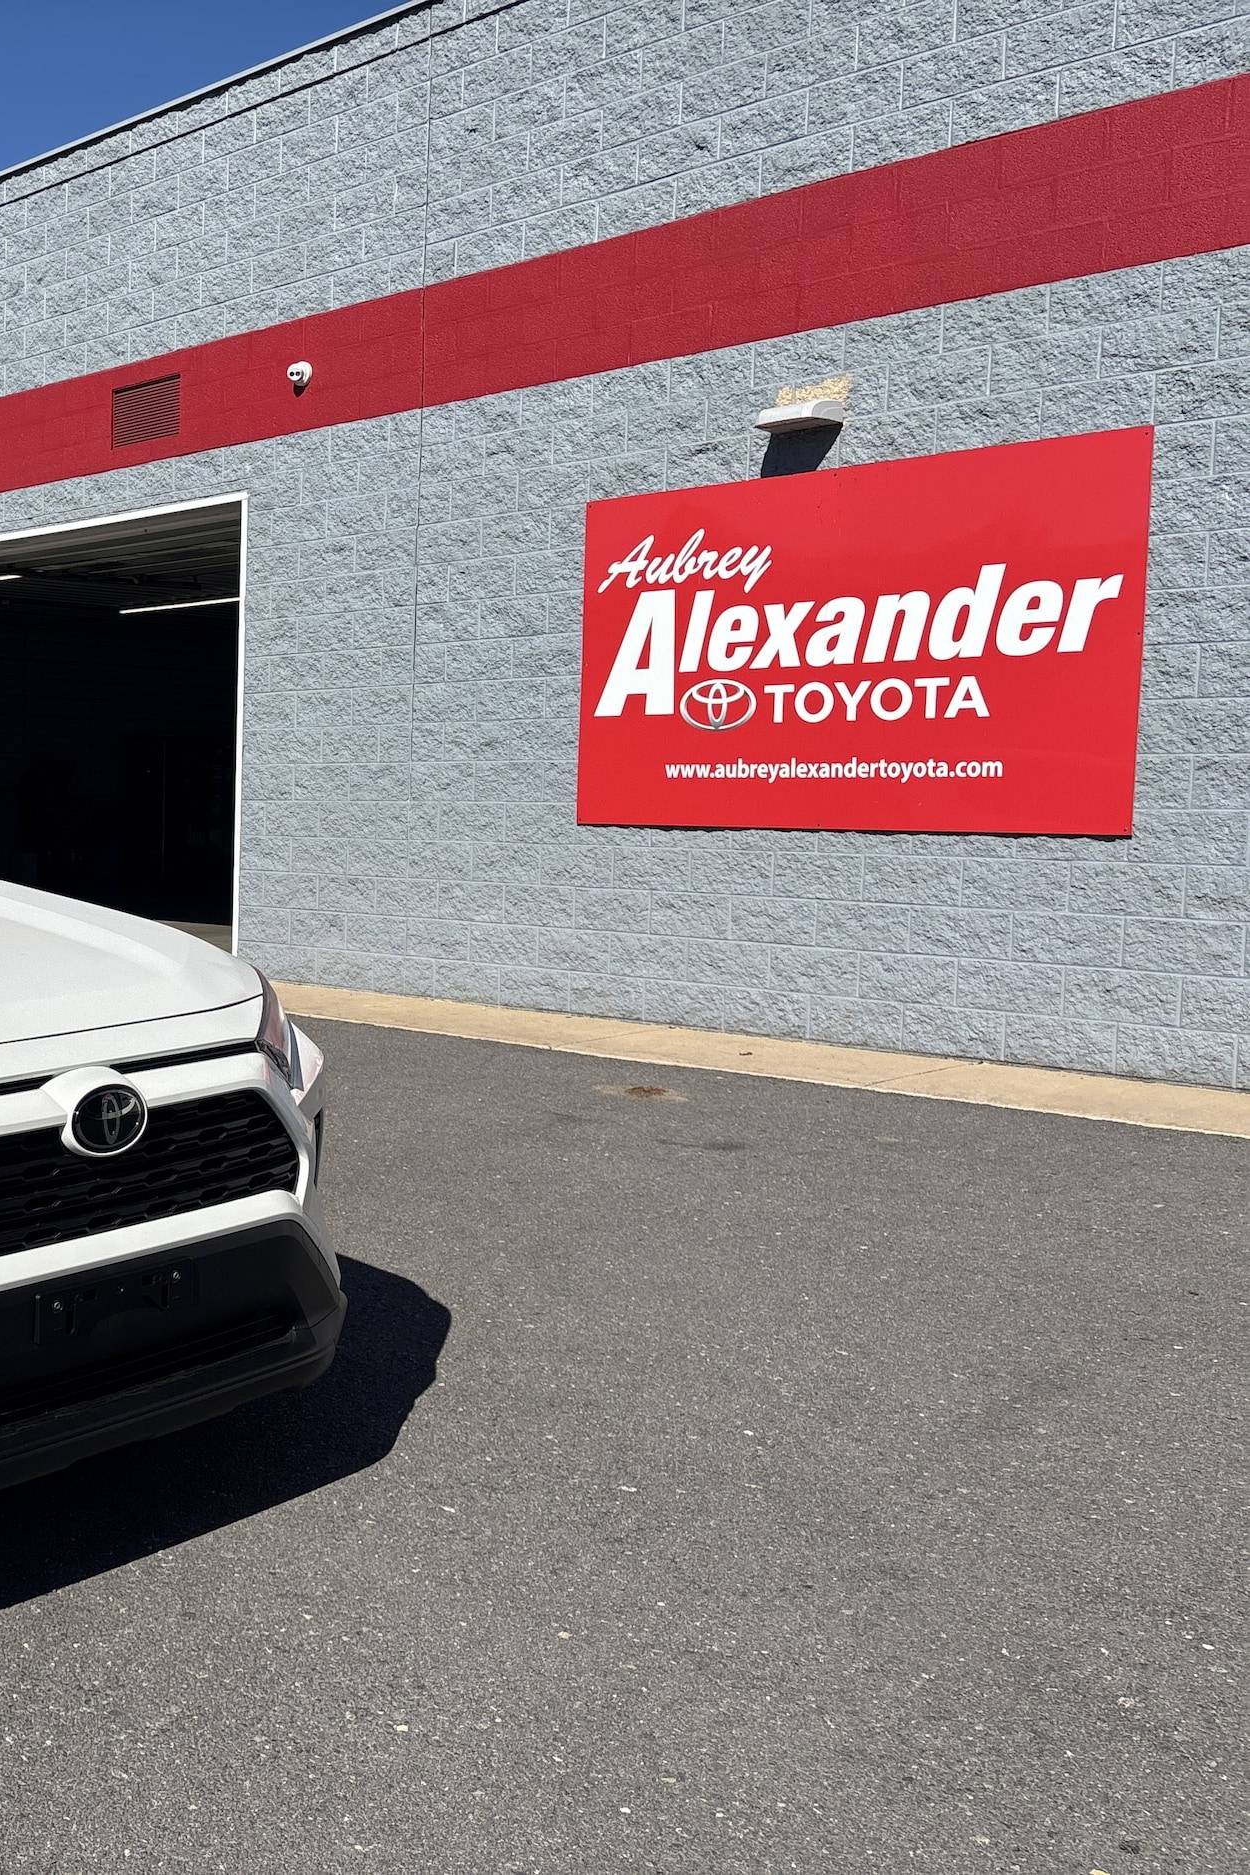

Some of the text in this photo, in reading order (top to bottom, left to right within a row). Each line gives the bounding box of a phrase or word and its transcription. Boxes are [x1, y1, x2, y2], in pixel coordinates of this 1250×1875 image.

[597, 528, 773, 594] Aubrey
[593, 563, 1124, 717] Alexander
[763, 675, 990, 724] TOYOTA
[665, 757, 1003, 784] www.aubreyalexandertoyota.com
